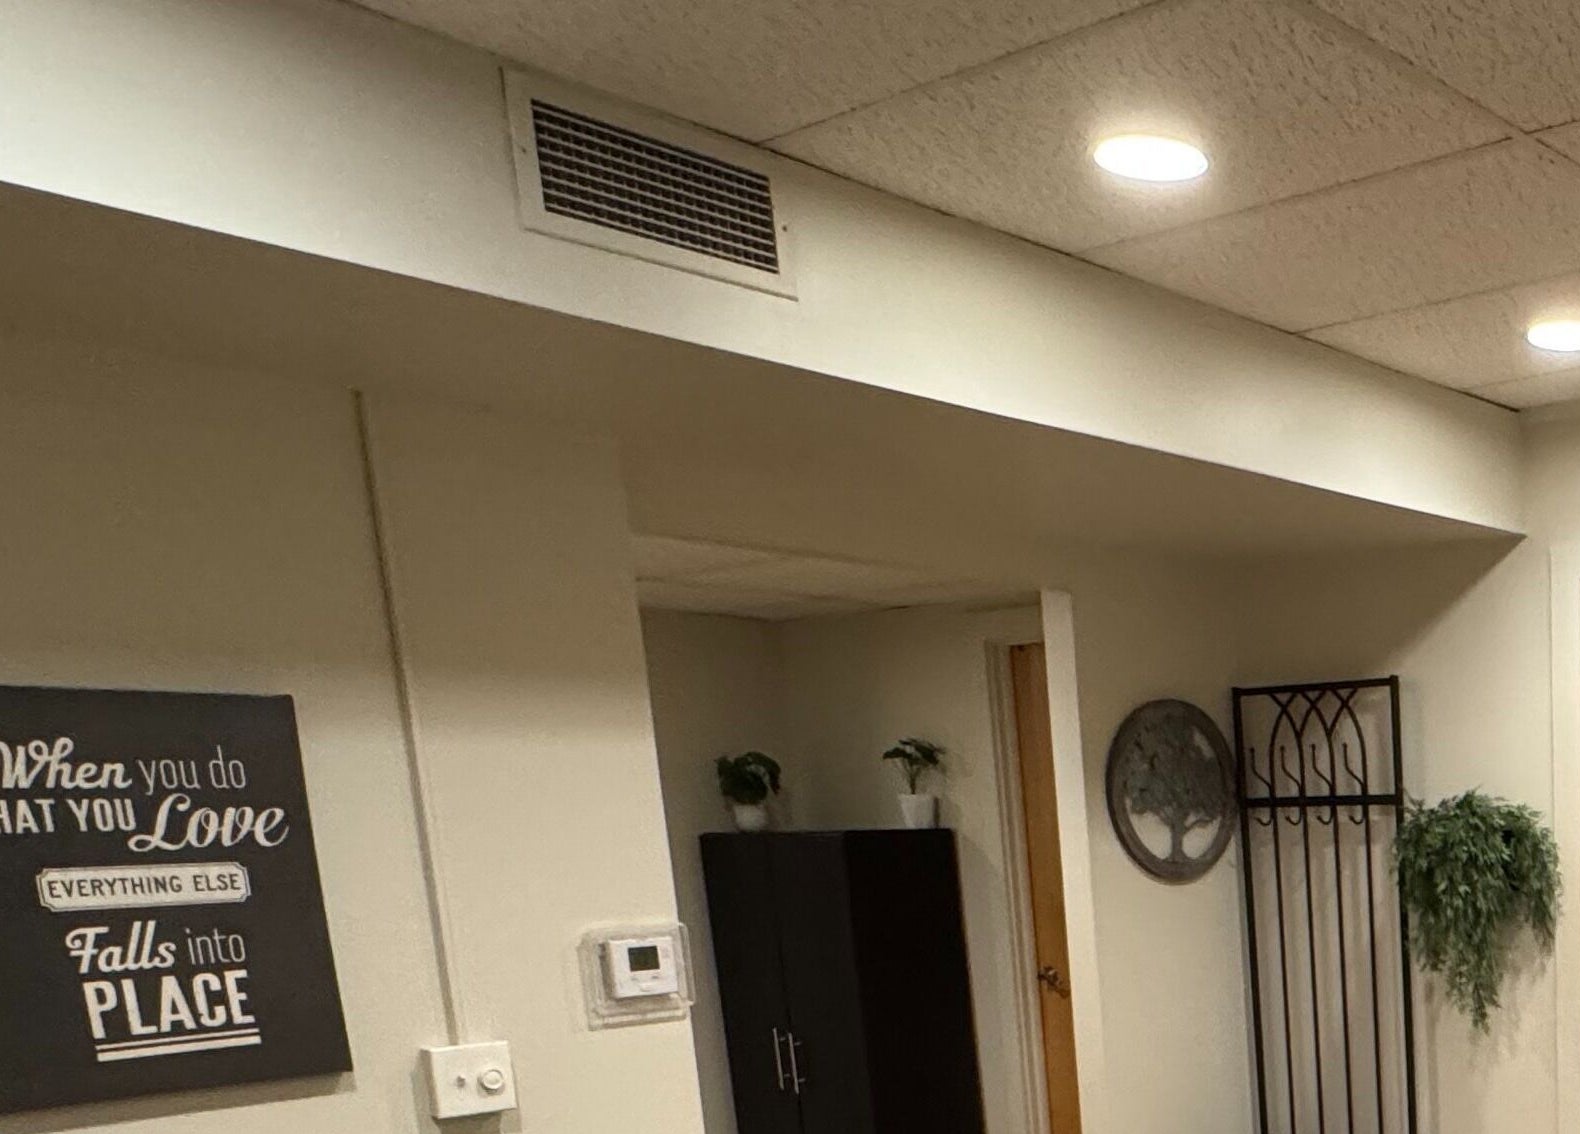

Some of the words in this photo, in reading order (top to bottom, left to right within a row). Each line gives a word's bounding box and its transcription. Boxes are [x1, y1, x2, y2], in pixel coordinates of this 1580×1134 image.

[0, 736, 132, 790] When
[138, 759, 201, 796] you
[208, 745, 246, 790] do
[66, 798, 137, 833] YOU
[128, 793, 289, 852] Love
[47, 875, 183, 899] EVERYTHING
[192, 873, 241, 892] ELSE
[65, 919, 177, 974] Falls
[187, 928, 246, 965] into
[82, 968, 256, 1040] PLACE
